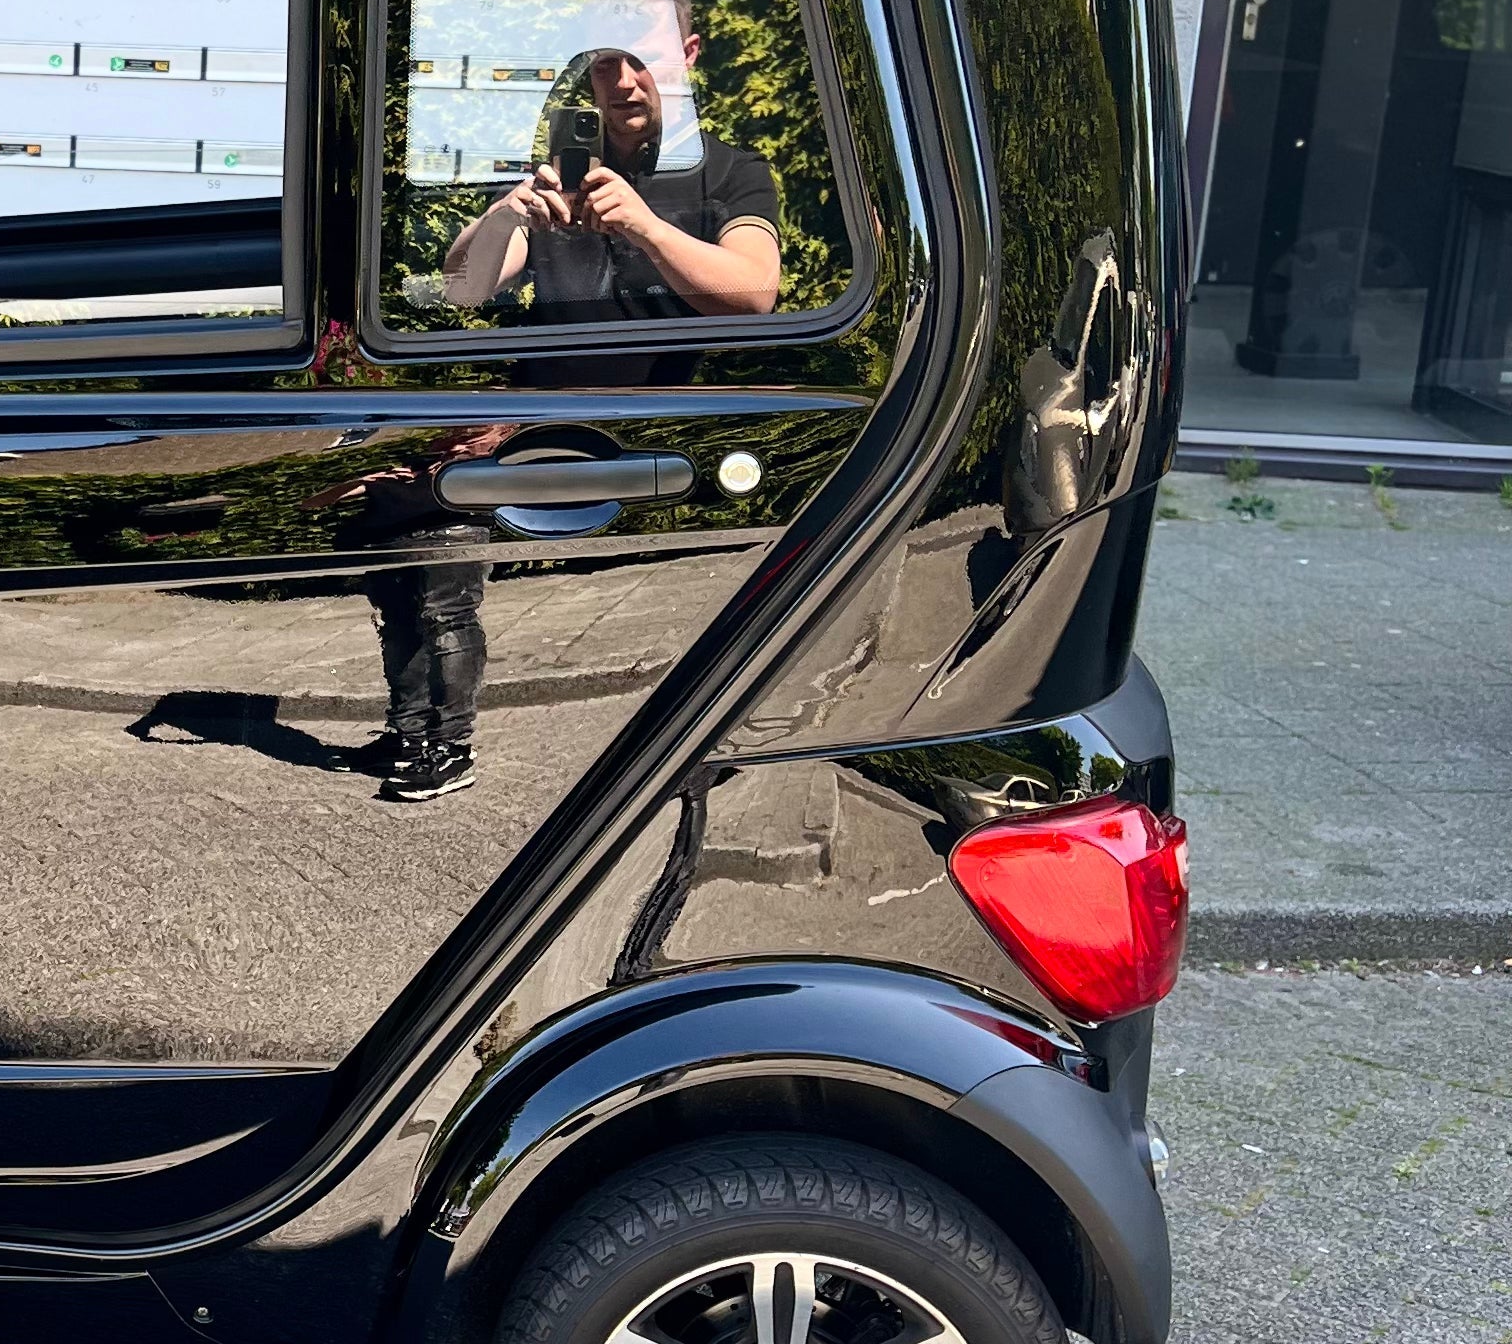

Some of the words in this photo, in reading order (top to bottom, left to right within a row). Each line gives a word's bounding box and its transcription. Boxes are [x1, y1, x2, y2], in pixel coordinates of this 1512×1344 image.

[85, 83, 99, 93] 45
[211, 87, 226, 97] 57
[208, 179, 221, 190] 59
